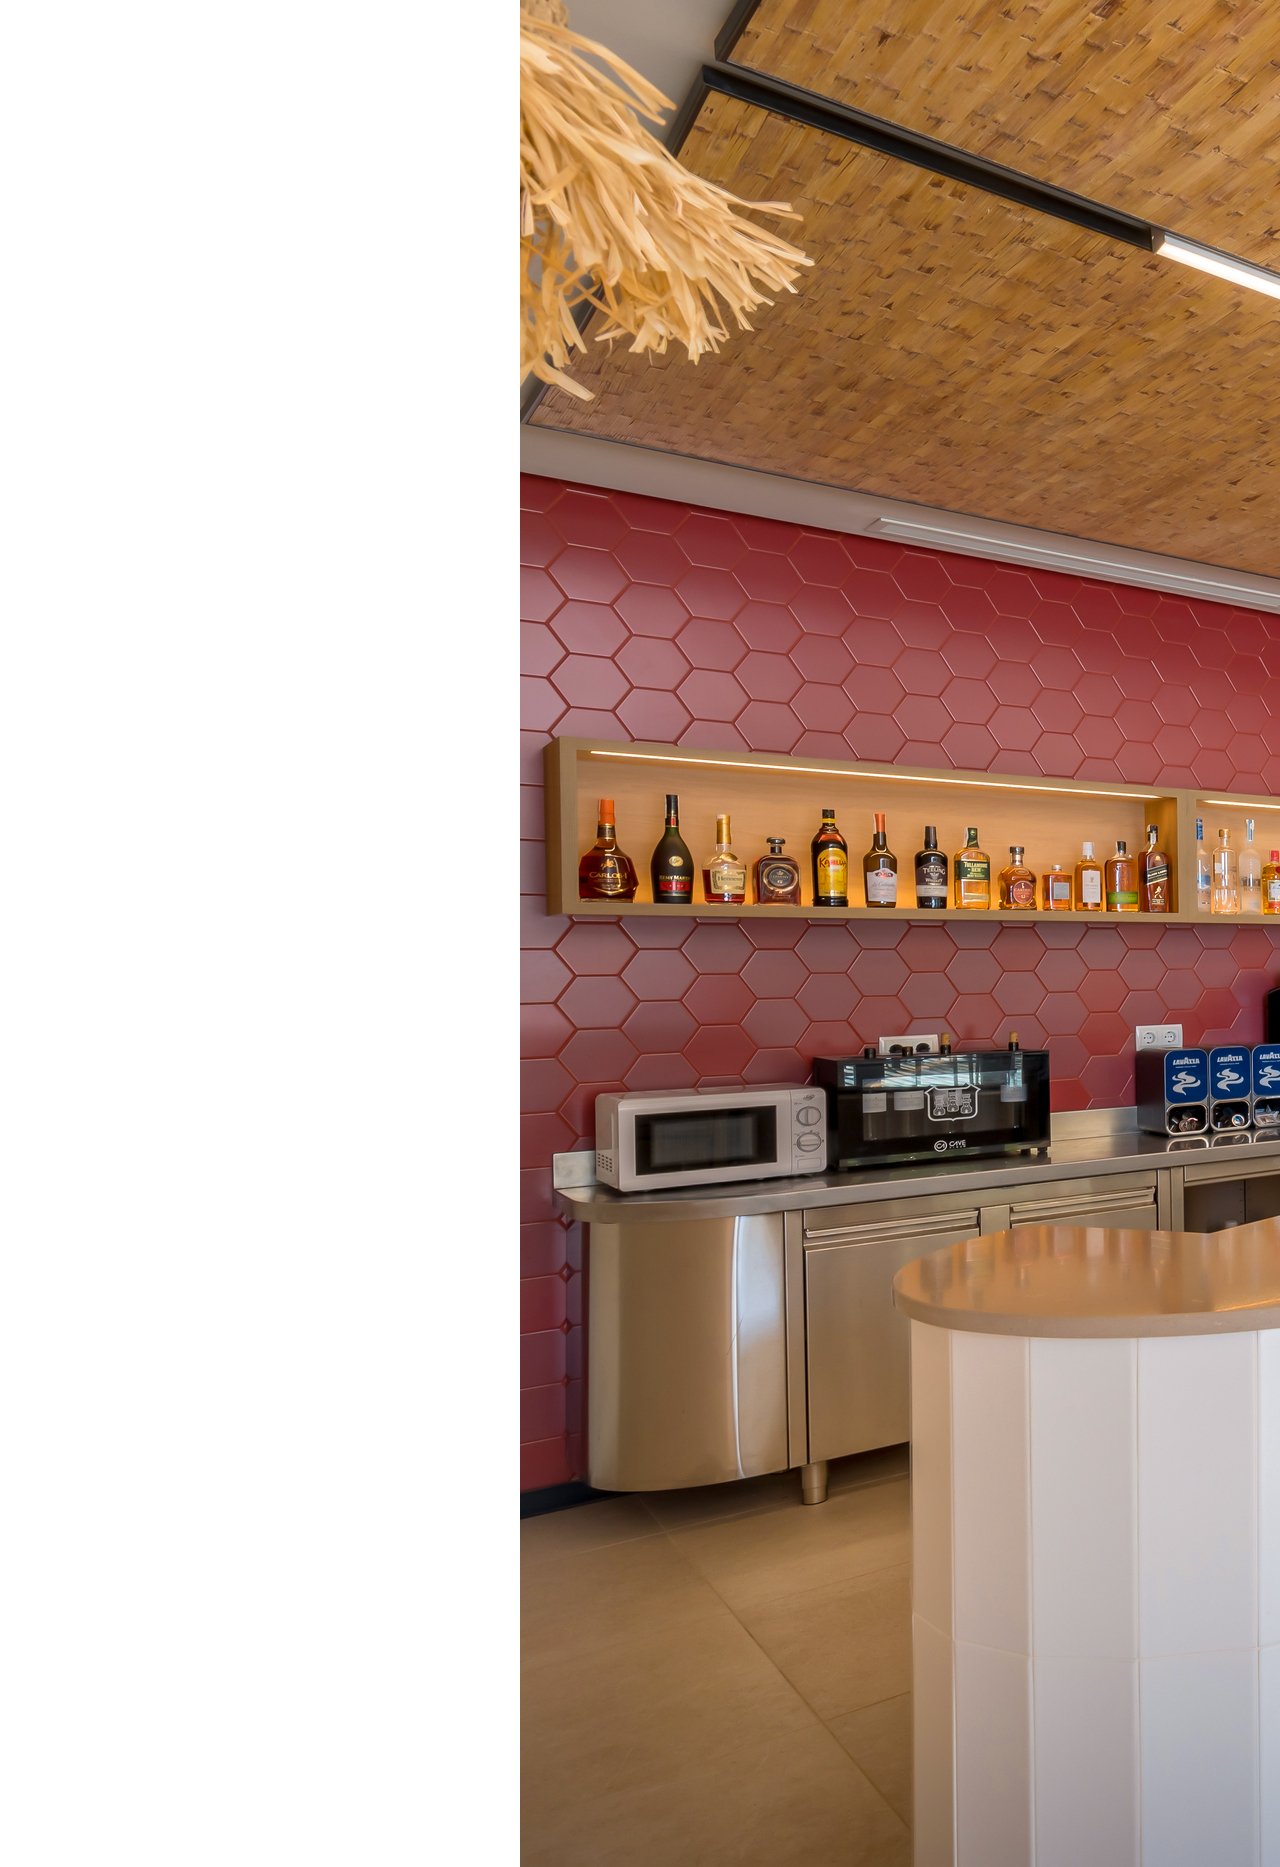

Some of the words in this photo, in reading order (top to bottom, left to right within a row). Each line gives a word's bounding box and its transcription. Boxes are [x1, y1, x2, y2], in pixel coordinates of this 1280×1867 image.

[922, 865, 946, 875] TEELING
[589, 871, 621, 879] CARLOS
[1172, 1056, 1201, 1066] LAVAZZA
[1216, 1054, 1243, 1063] LAVAZZA
